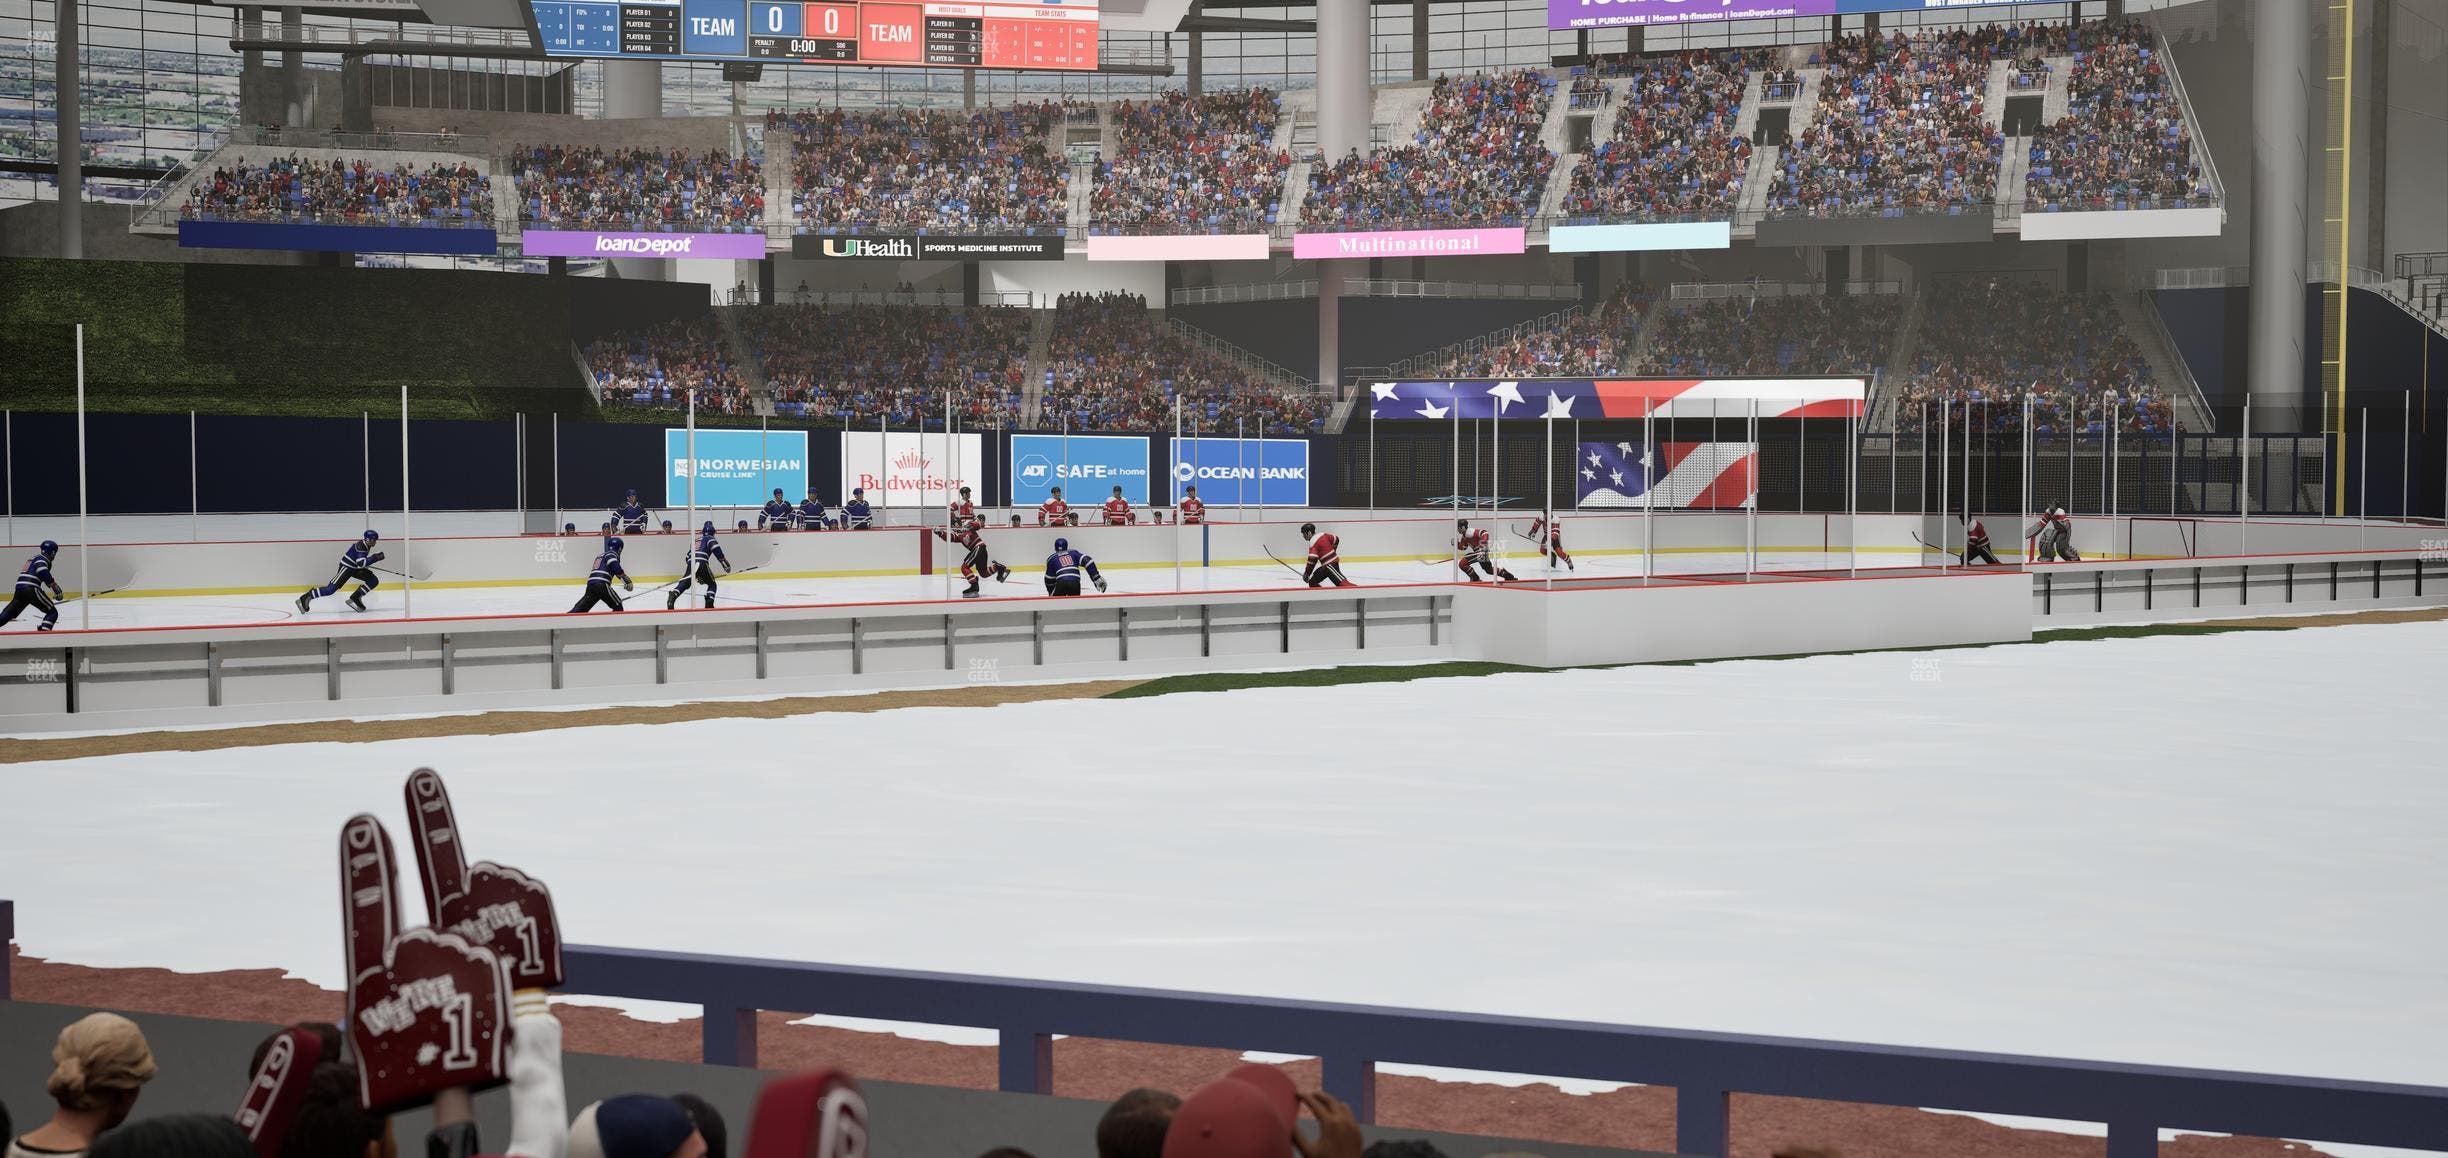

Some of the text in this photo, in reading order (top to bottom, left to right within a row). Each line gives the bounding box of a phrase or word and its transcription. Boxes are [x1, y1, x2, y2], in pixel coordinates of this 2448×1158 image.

[768, 6, 783, 32] 0
[824, 8, 839, 34] 0
[1570, 18, 1596, 26] HOME
[1598, 15, 1646, 25] PURCHASE
[1652, 14, 1677, 22] Home
[1730, 8, 1796, 18] loanDepot.com
[691, 17, 735, 37] TEAM
[869, 23, 913, 43] TEAM
[626, 33, 644, 41] PLAYER
[791, 39, 816, 53] 0:00
[595, 235, 692, 256] loanDepot
[823, 238, 1042, 257] UHealth SPORTS MEDICINE INSTITUTE
[1338, 234, 1480, 253] Multinational
[700, 459, 801, 471] NORWEGIAN
[1021, 466, 1046, 477] ADT
[1056, 465, 1107, 479] SAFE
[1119, 468, 1146, 476] home
[1197, 467, 1306, 480] OCEAN BANK
[700, 471, 731, 479] CRUISE
[859, 474, 965, 491] Budweiser
